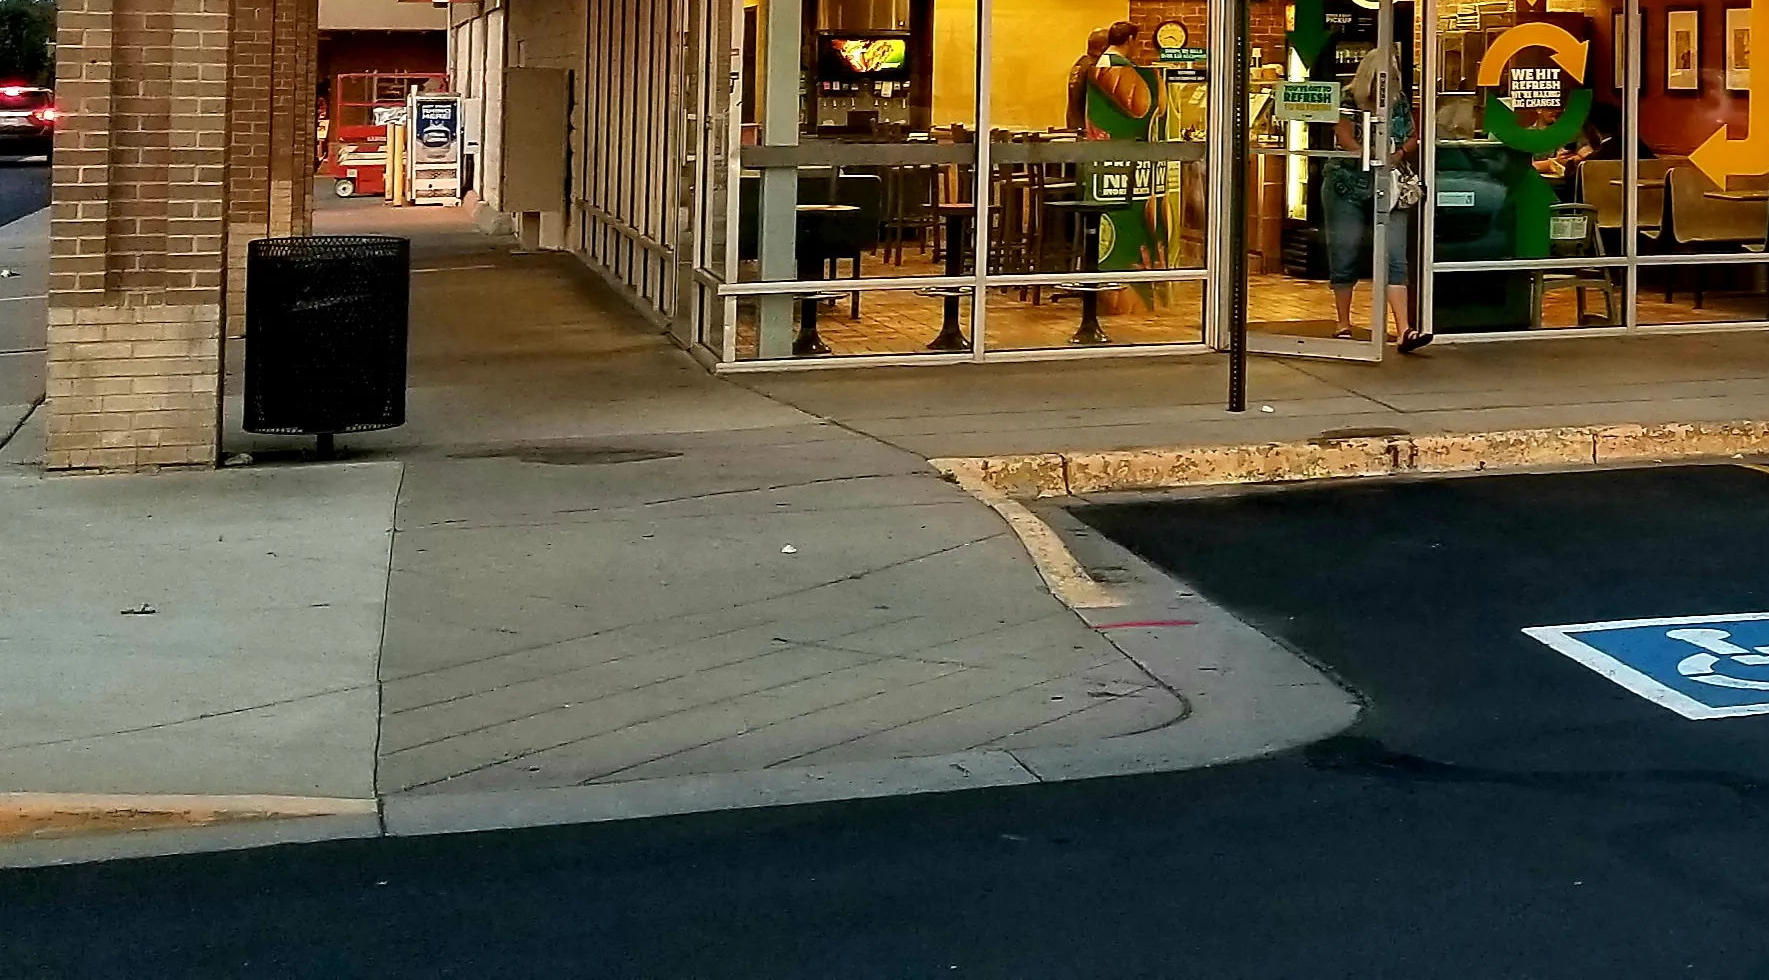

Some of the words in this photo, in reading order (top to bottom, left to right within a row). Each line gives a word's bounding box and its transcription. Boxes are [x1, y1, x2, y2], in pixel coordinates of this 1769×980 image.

[1511, 68, 1534, 80] WE
[1535, 68, 1561, 80] HIT
[1511, 80, 1561, 90] REFRESH
[1283, 92, 1332, 103] REFRESH
[1525, 99, 1561, 107] CHANGES
